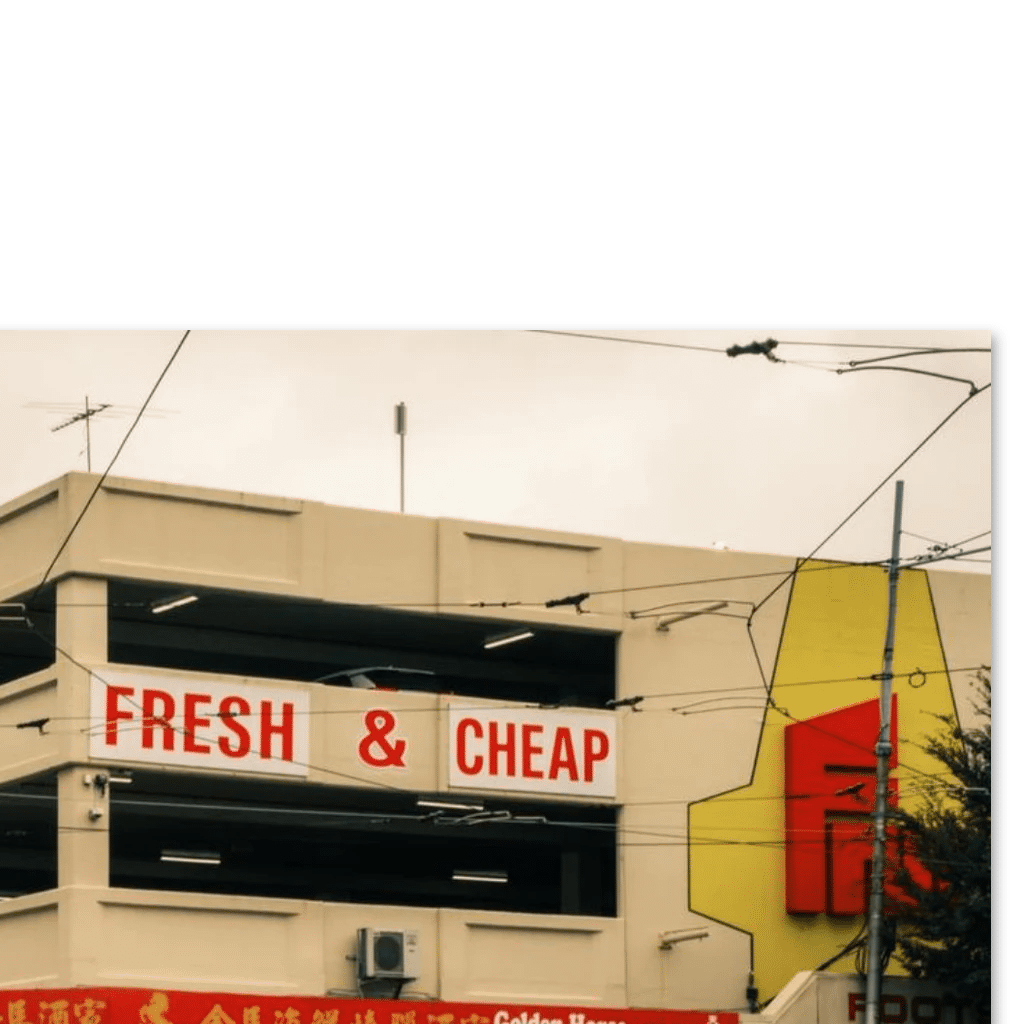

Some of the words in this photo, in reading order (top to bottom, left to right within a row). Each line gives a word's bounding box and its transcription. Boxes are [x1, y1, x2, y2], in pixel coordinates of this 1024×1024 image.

[104, 685, 295, 763] FRESH
[358, 708, 406, 769] &
[455, 717, 610, 783] CHEAP
